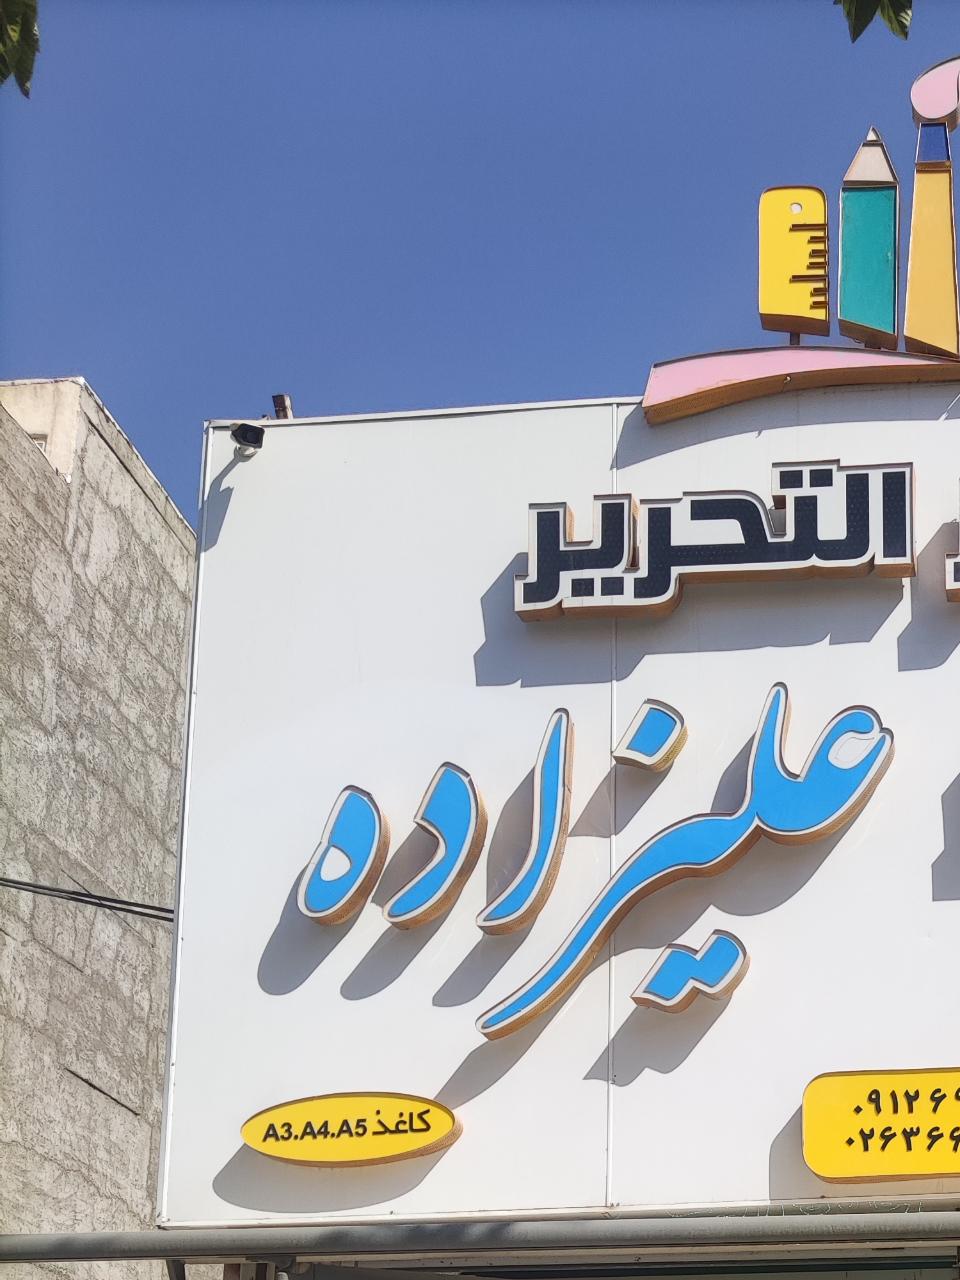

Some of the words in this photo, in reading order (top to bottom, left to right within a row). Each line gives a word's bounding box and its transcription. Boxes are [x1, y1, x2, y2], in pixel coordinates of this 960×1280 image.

[522, 468, 908, 604] التحریر
[303, 687, 890, 1032] علیزاده
[262, 1118, 368, 1143] A3.A4.A5
[372, 1109, 432, 1135] کاغذ
